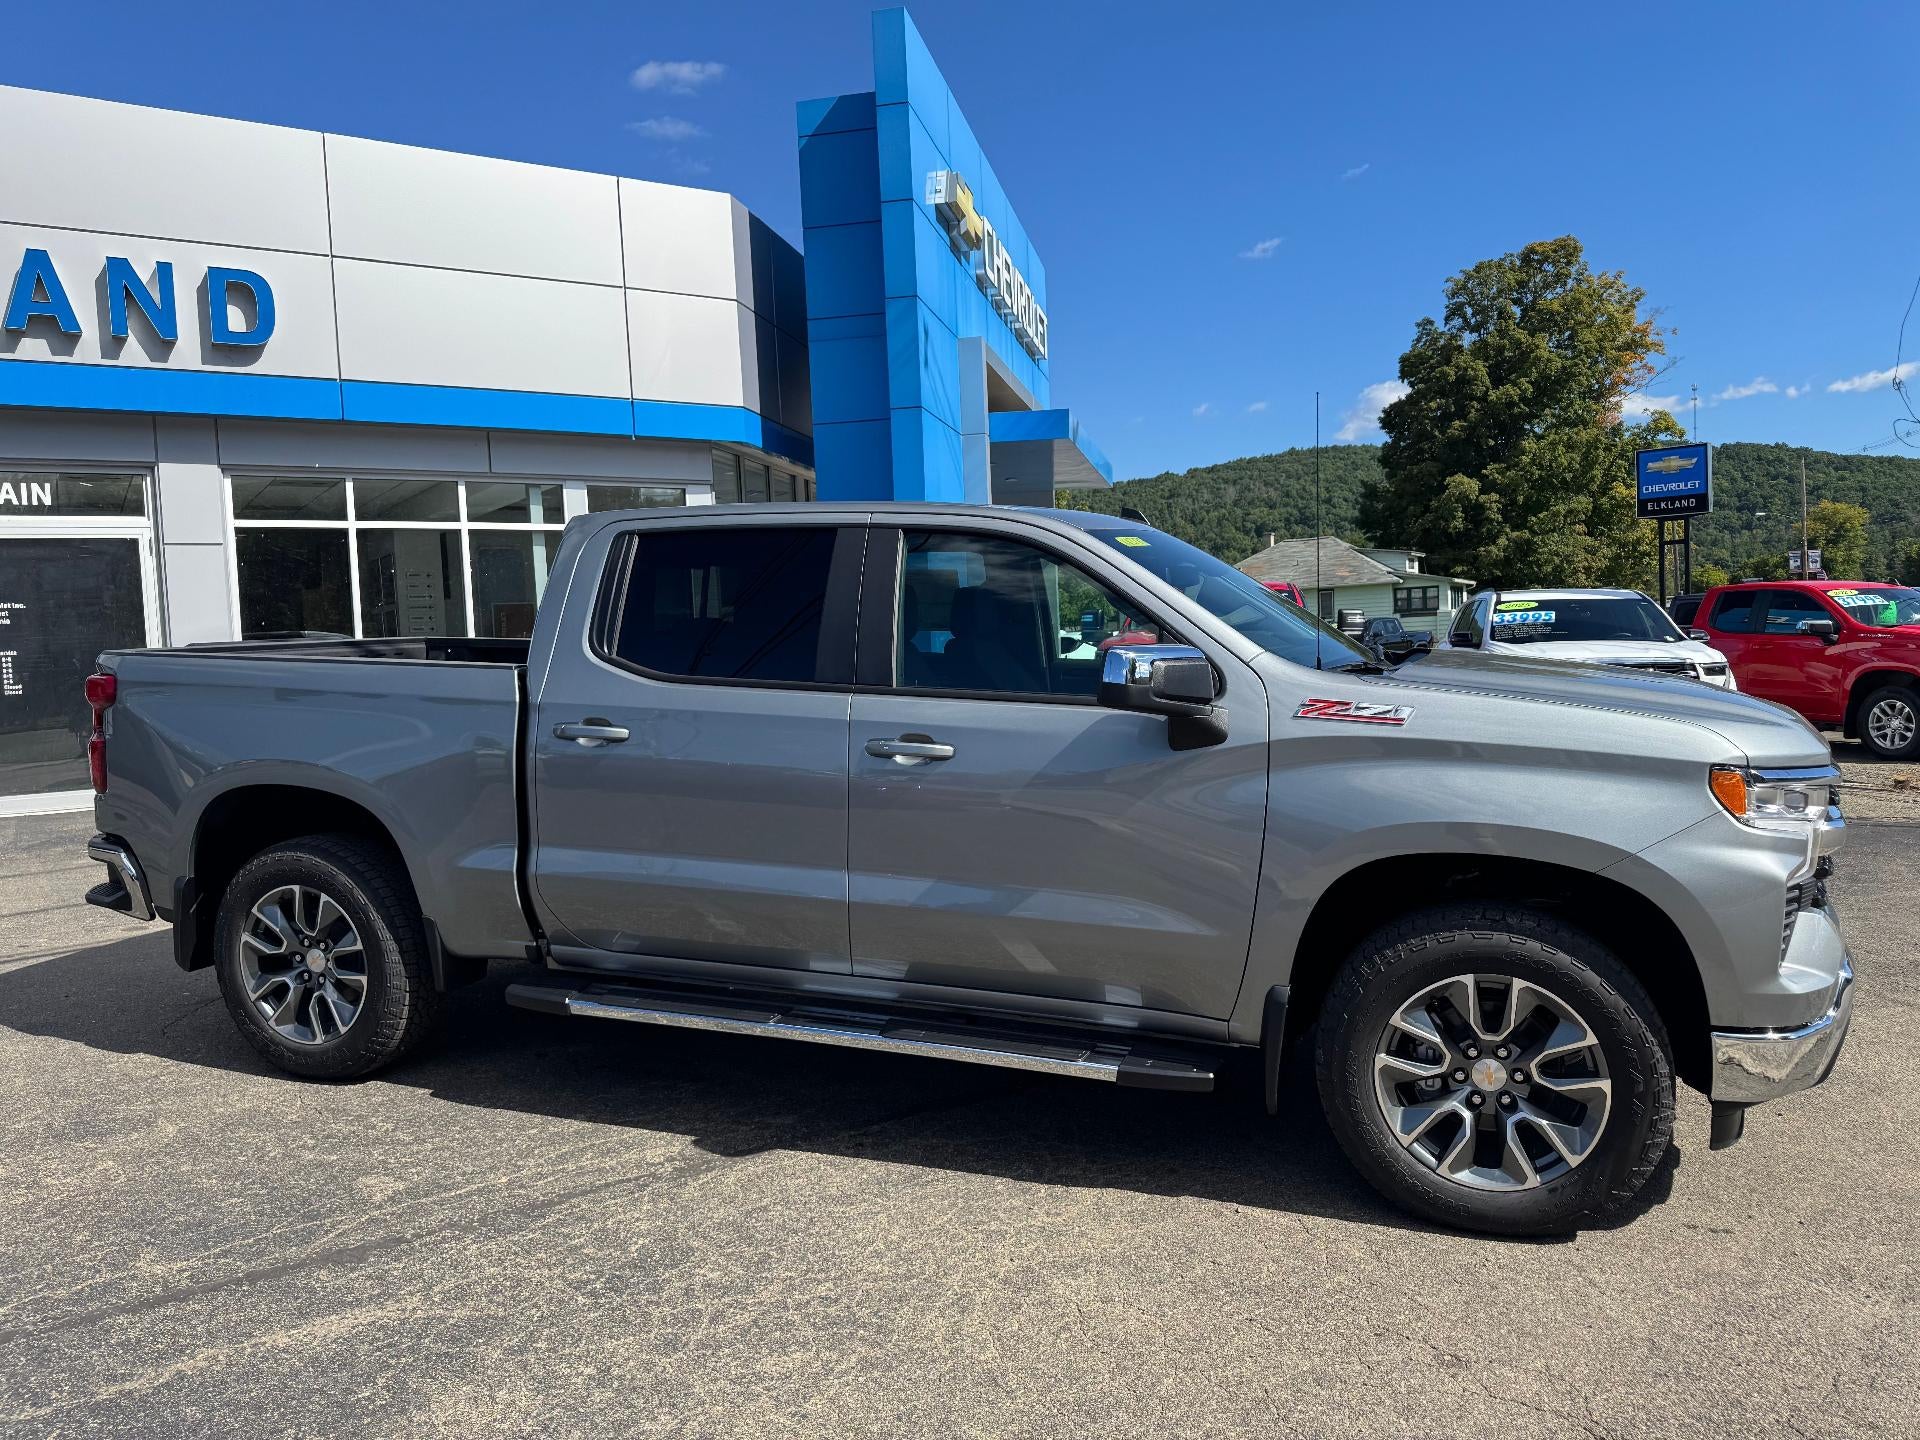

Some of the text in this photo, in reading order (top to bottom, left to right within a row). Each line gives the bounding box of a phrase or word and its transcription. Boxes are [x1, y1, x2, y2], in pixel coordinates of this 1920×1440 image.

[981, 215, 1048, 360] CHEVROLET
[1642, 480, 1701, 494] CHEVROLET
[1647, 498, 1696, 510] ELKLAND
[1494, 611, 1554, 624] 33995
[1293, 698, 1416, 726] Z71
